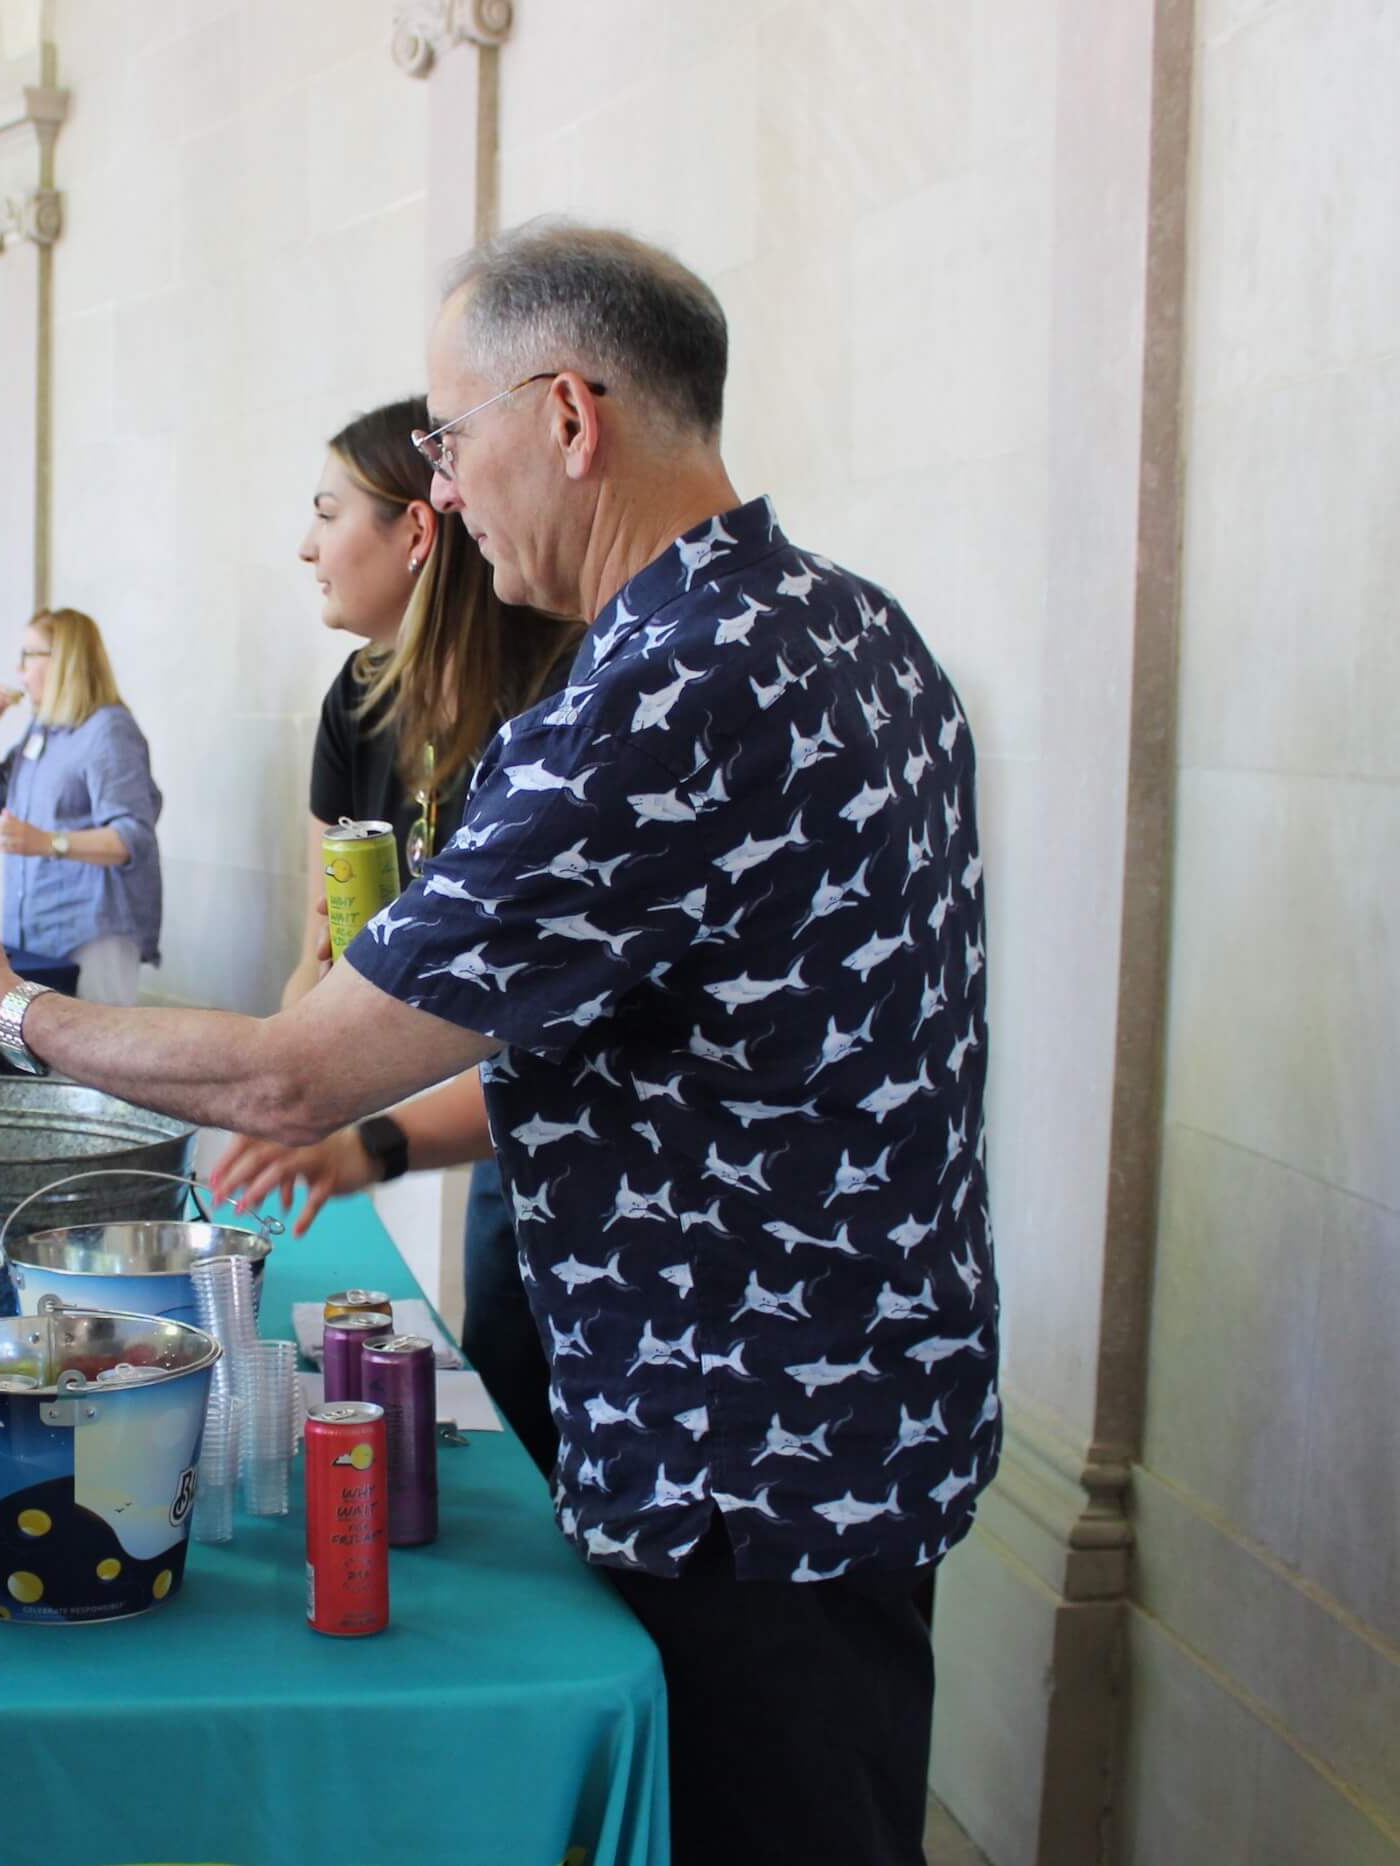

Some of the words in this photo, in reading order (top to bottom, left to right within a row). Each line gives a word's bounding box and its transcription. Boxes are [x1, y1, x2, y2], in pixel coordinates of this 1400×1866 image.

[342, 1484, 376, 1498] WHY
[337, 1502, 377, 1517] WAIT
[22, 1605, 68, 1616] CELEBRATE
